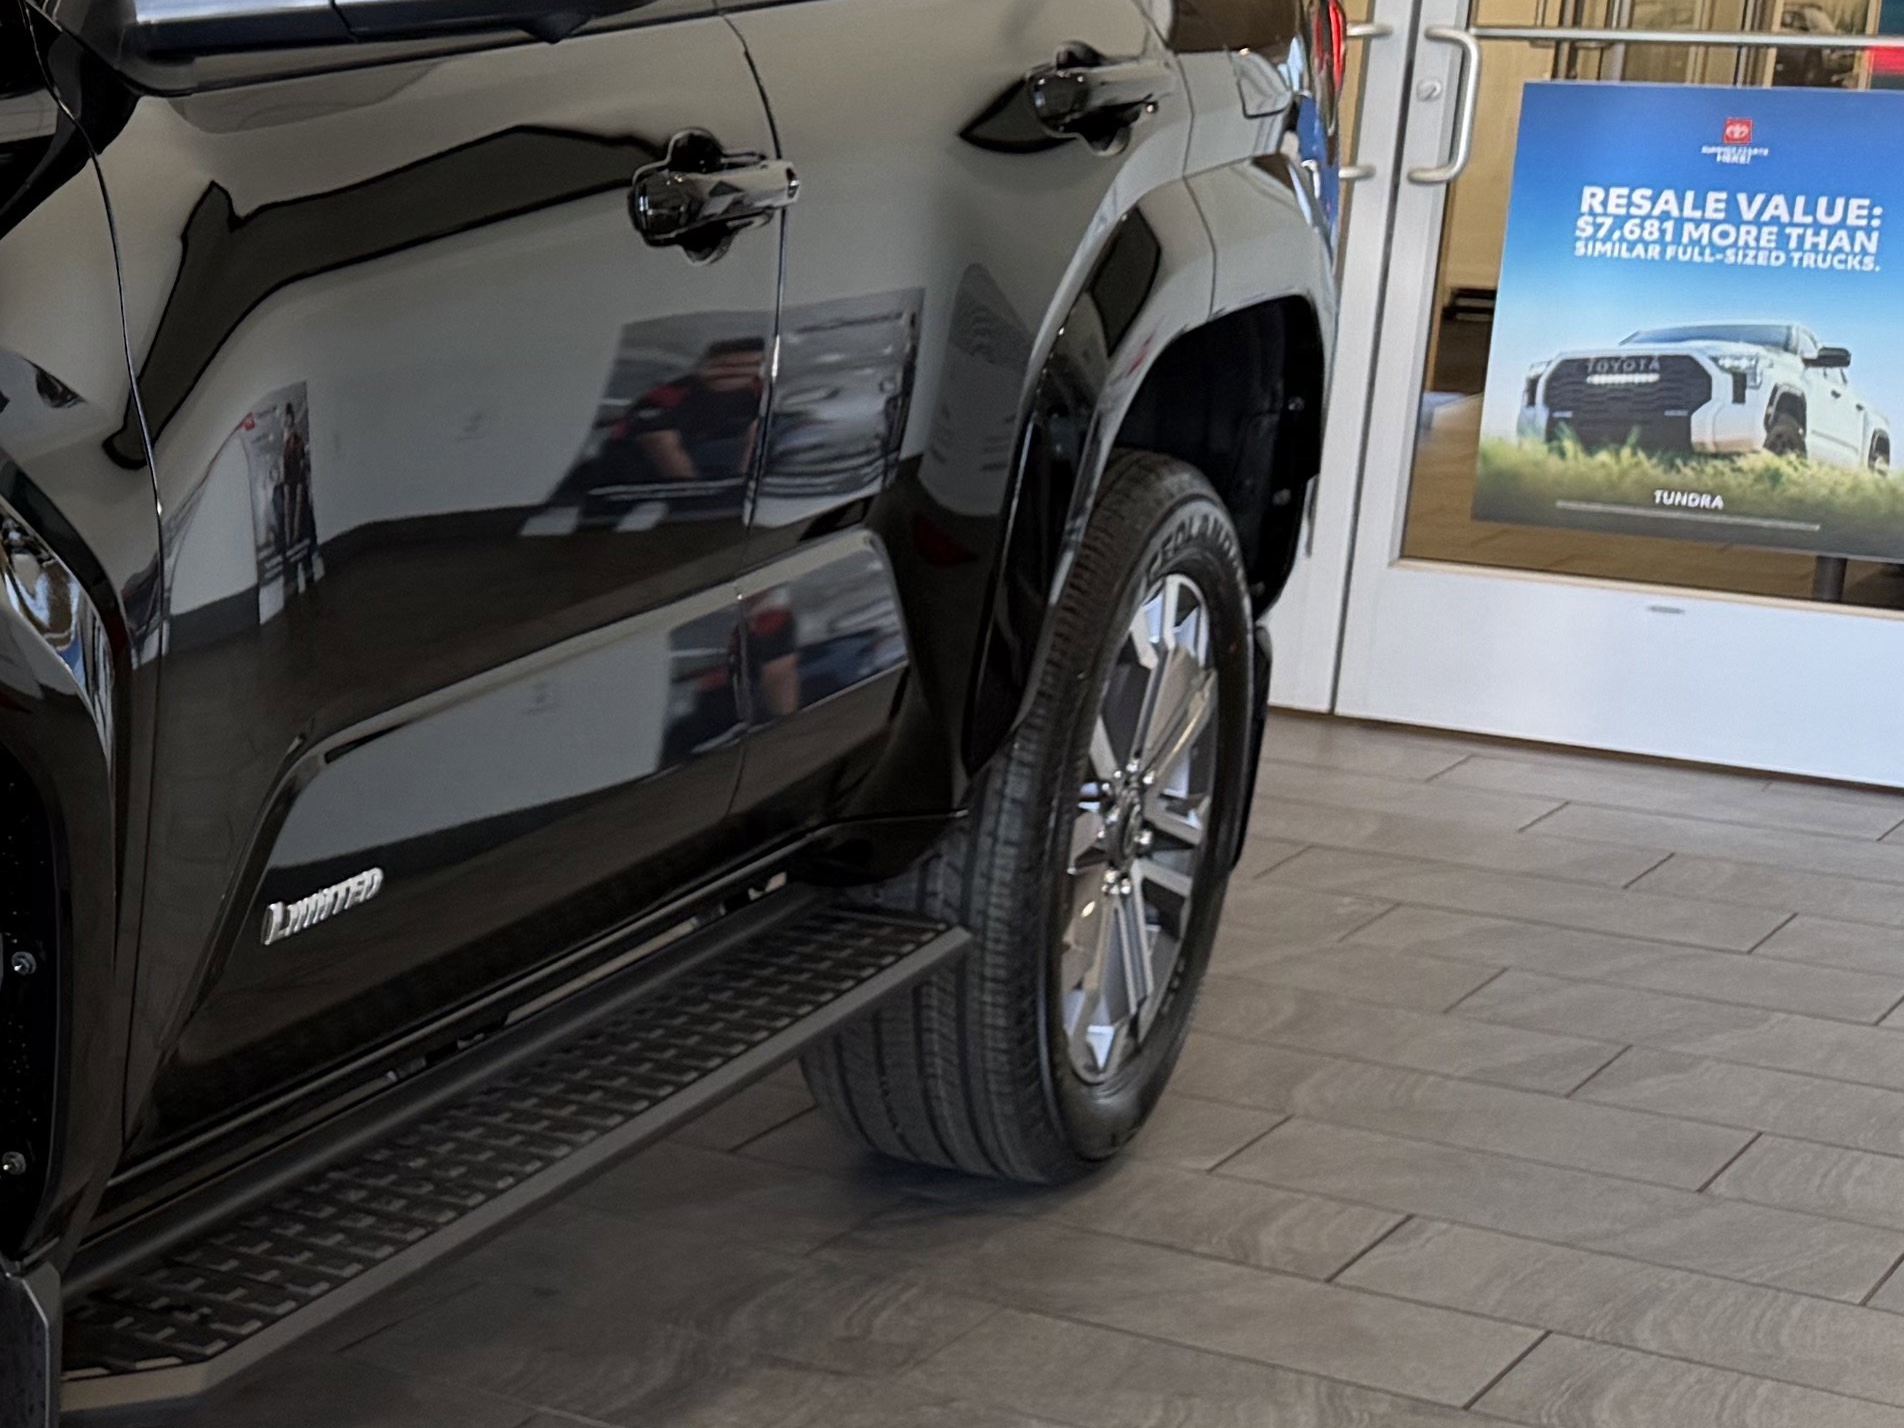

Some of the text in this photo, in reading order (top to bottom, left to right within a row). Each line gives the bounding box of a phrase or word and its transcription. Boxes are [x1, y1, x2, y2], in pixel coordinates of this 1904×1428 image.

[1580, 185, 1883, 228] RESALE VALUE:
[1575, 213, 1879, 254] $7,681 MORE THAN
[1574, 240, 1881, 272] SIMILAR FULL-SIZED TRUCKS.
[1653, 489, 1724, 510] TUNDRA
